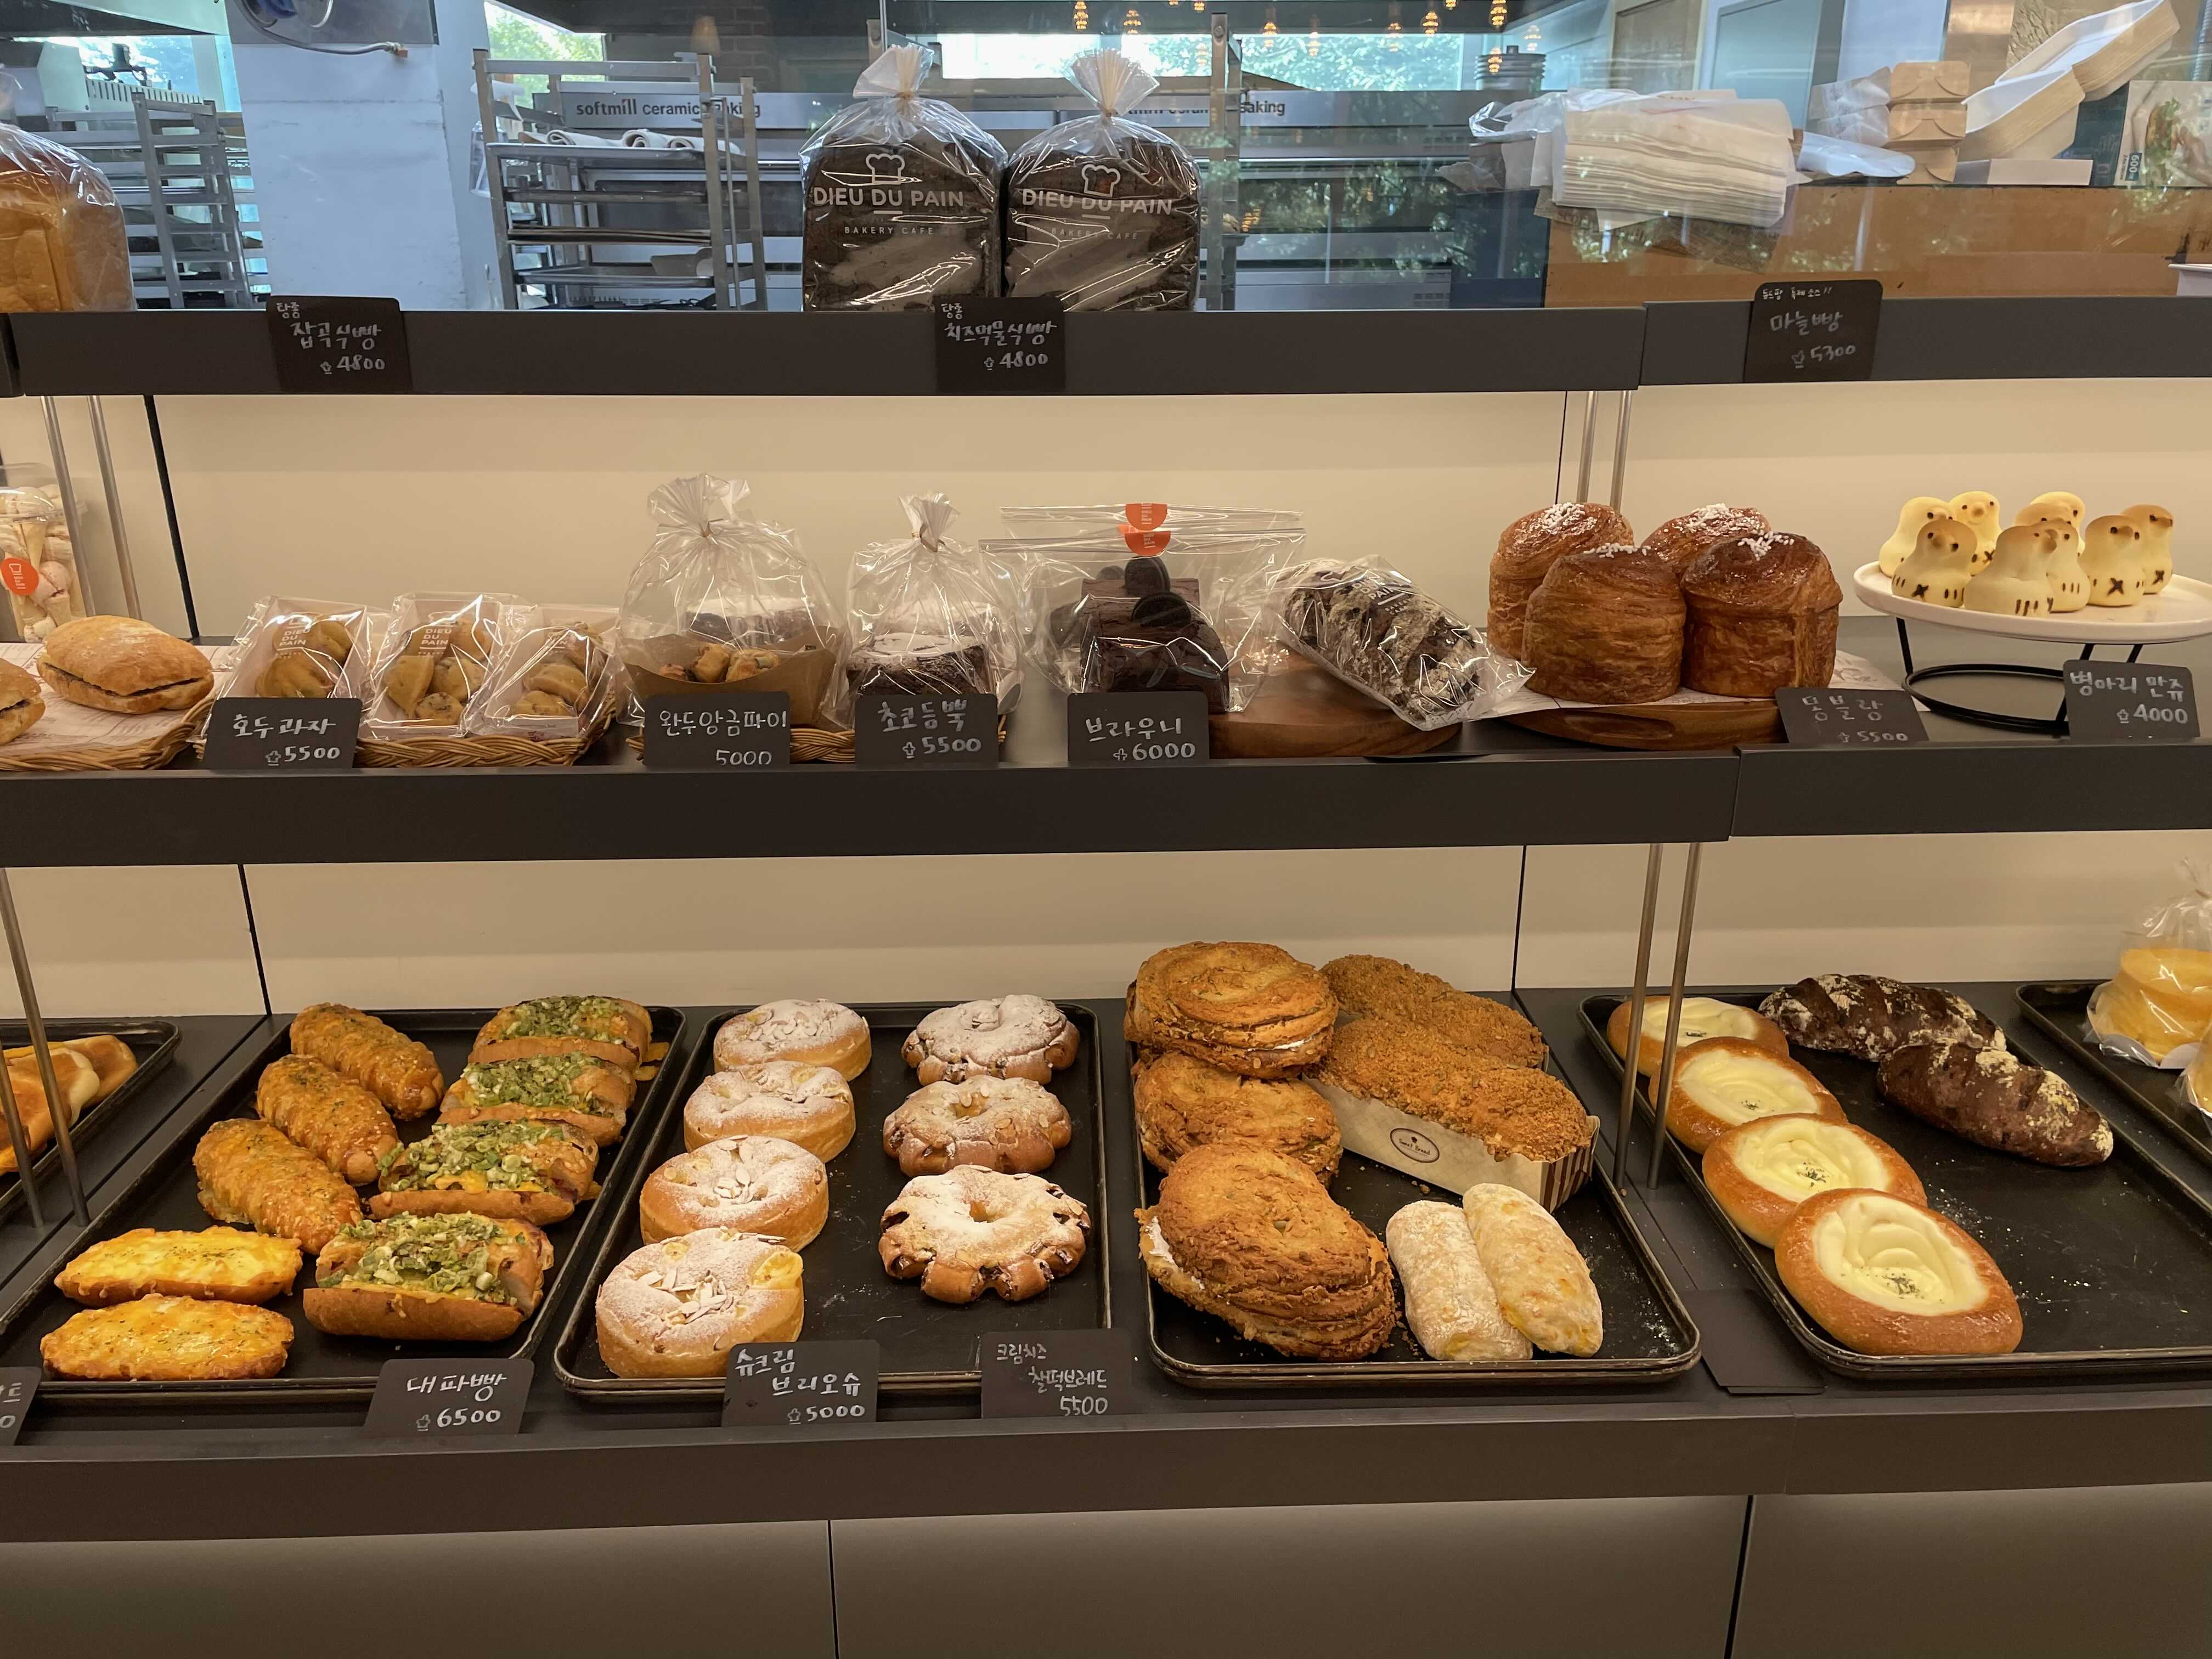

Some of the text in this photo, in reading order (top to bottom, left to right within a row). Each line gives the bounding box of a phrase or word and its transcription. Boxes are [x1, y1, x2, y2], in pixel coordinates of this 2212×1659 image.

[576, 99, 637, 115] softmill
[642, 102, 699, 115] ceramic
[814, 187, 964, 207] DIEU DU PAIN
[1022, 188, 1172, 215] DIEU DU PAIN
[844, 226, 934, 235] BAKERY CAFE
[276, 301, 300, 319] 탕종
[940, 302, 963, 320] 탕종
[944, 320, 1058, 347] 치즈먹물식빵
[1769, 310, 1844, 336] 마늘빵
[289, 321, 382, 351] 잡곡식빵
[336, 354, 386, 371] 4800
[998, 351, 1049, 369] 4800
[1810, 345, 1857, 362] 5300
[2069, 671, 2185, 702] 병아리 만쥬
[877, 698, 968, 732] 초코듬뿍
[1802, 695, 1883, 721] 몽블랑
[2132, 703, 2188, 724] 4000
[232, 713, 337, 739] 호두과자
[659, 709, 787, 737] 완두앙금파이
[1085, 716, 1182, 742] 브라우니
[921, 736, 982, 754] 5500
[1857, 730, 1909, 742] 5500
[284, 746, 341, 763] 5500
[716, 749, 772, 765] 5000
[1132, 742, 1196, 761] 6000
[735, 1348, 796, 1377] 슈크림
[996, 1342, 1047, 1364] 크림치즈
[407, 1373, 508, 1402] 대파빵
[772, 1372, 861, 1397] 브리오슈
[1028, 1365, 1108, 1394] 찰떡브레드
[806, 1404, 866, 1422] 5000
[1060, 1395, 1108, 1417] 5500
[437, 1407, 501, 1429] 6500
